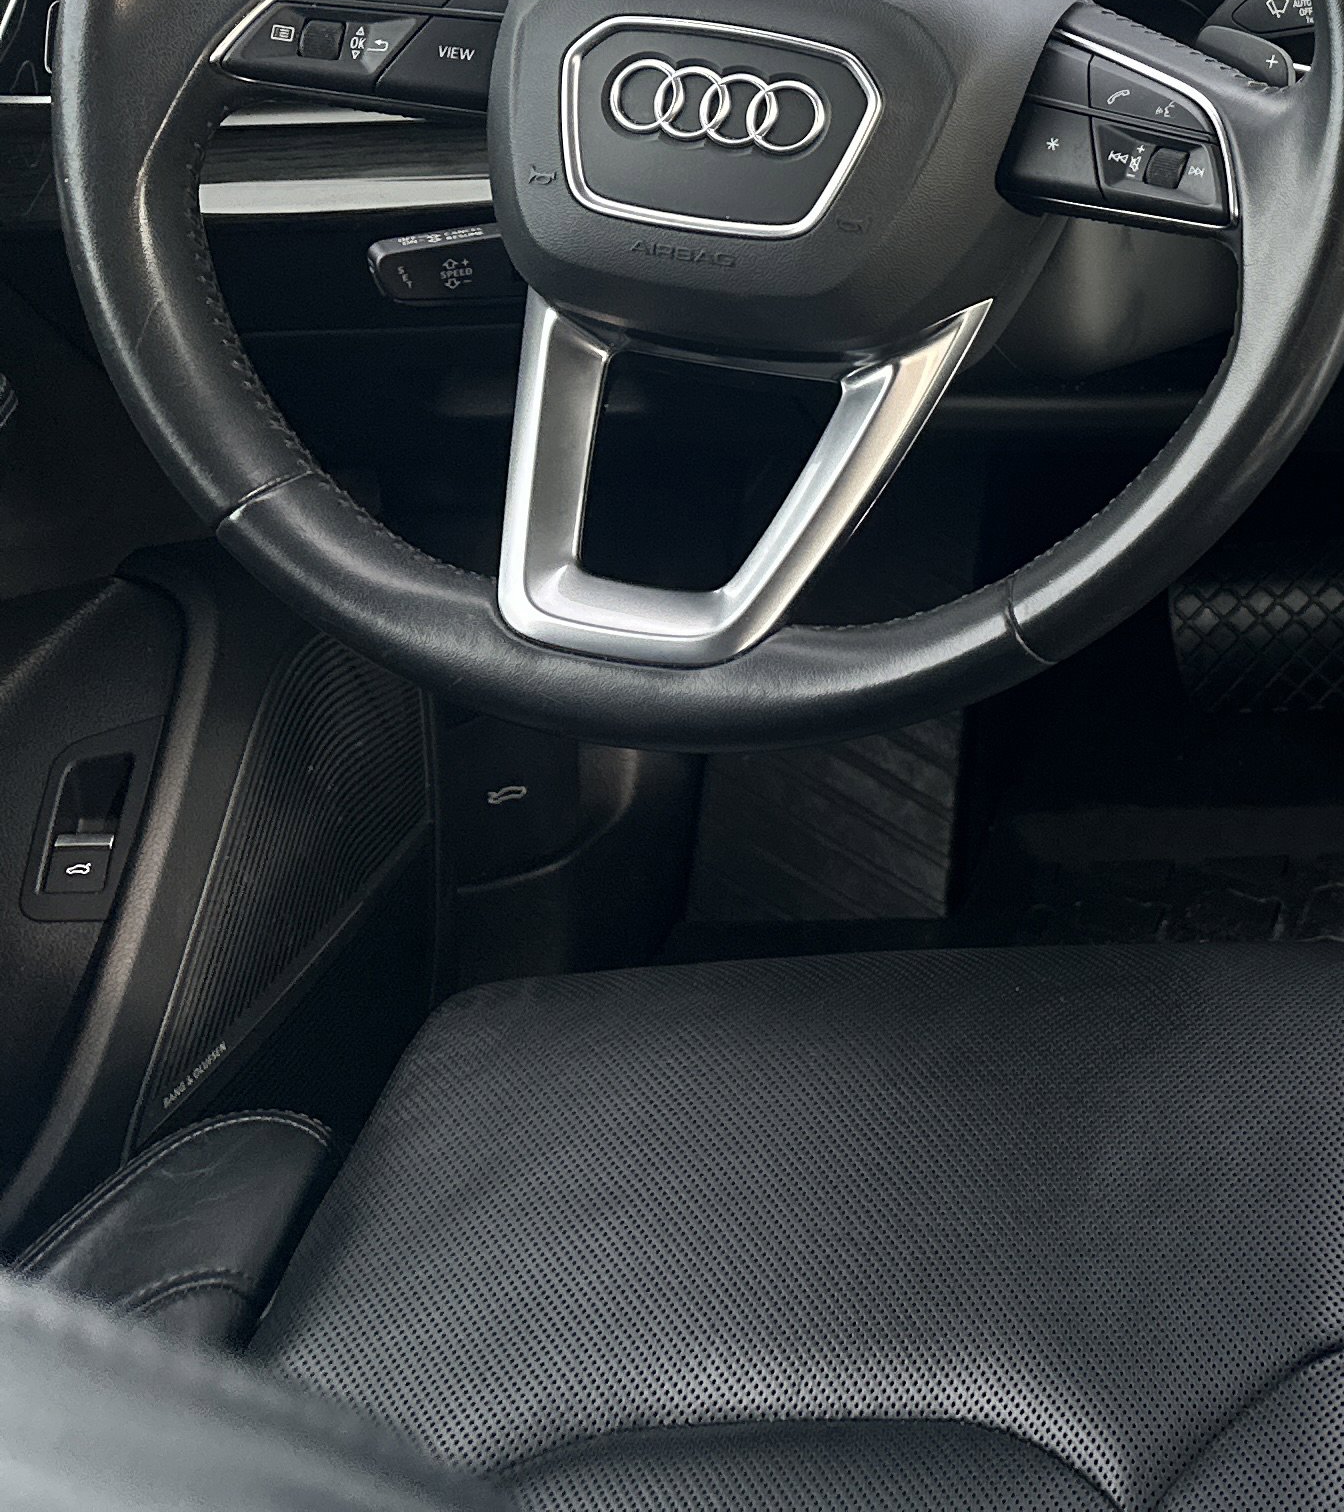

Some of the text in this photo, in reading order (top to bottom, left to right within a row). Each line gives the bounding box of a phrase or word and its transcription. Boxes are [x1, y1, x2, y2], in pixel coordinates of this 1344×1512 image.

[350, 37, 367, 50] OK
[438, 45, 475, 61] VIEW
[630, 240, 737, 268] AIRBAG
[440, 268, 473, 279] SPEED
